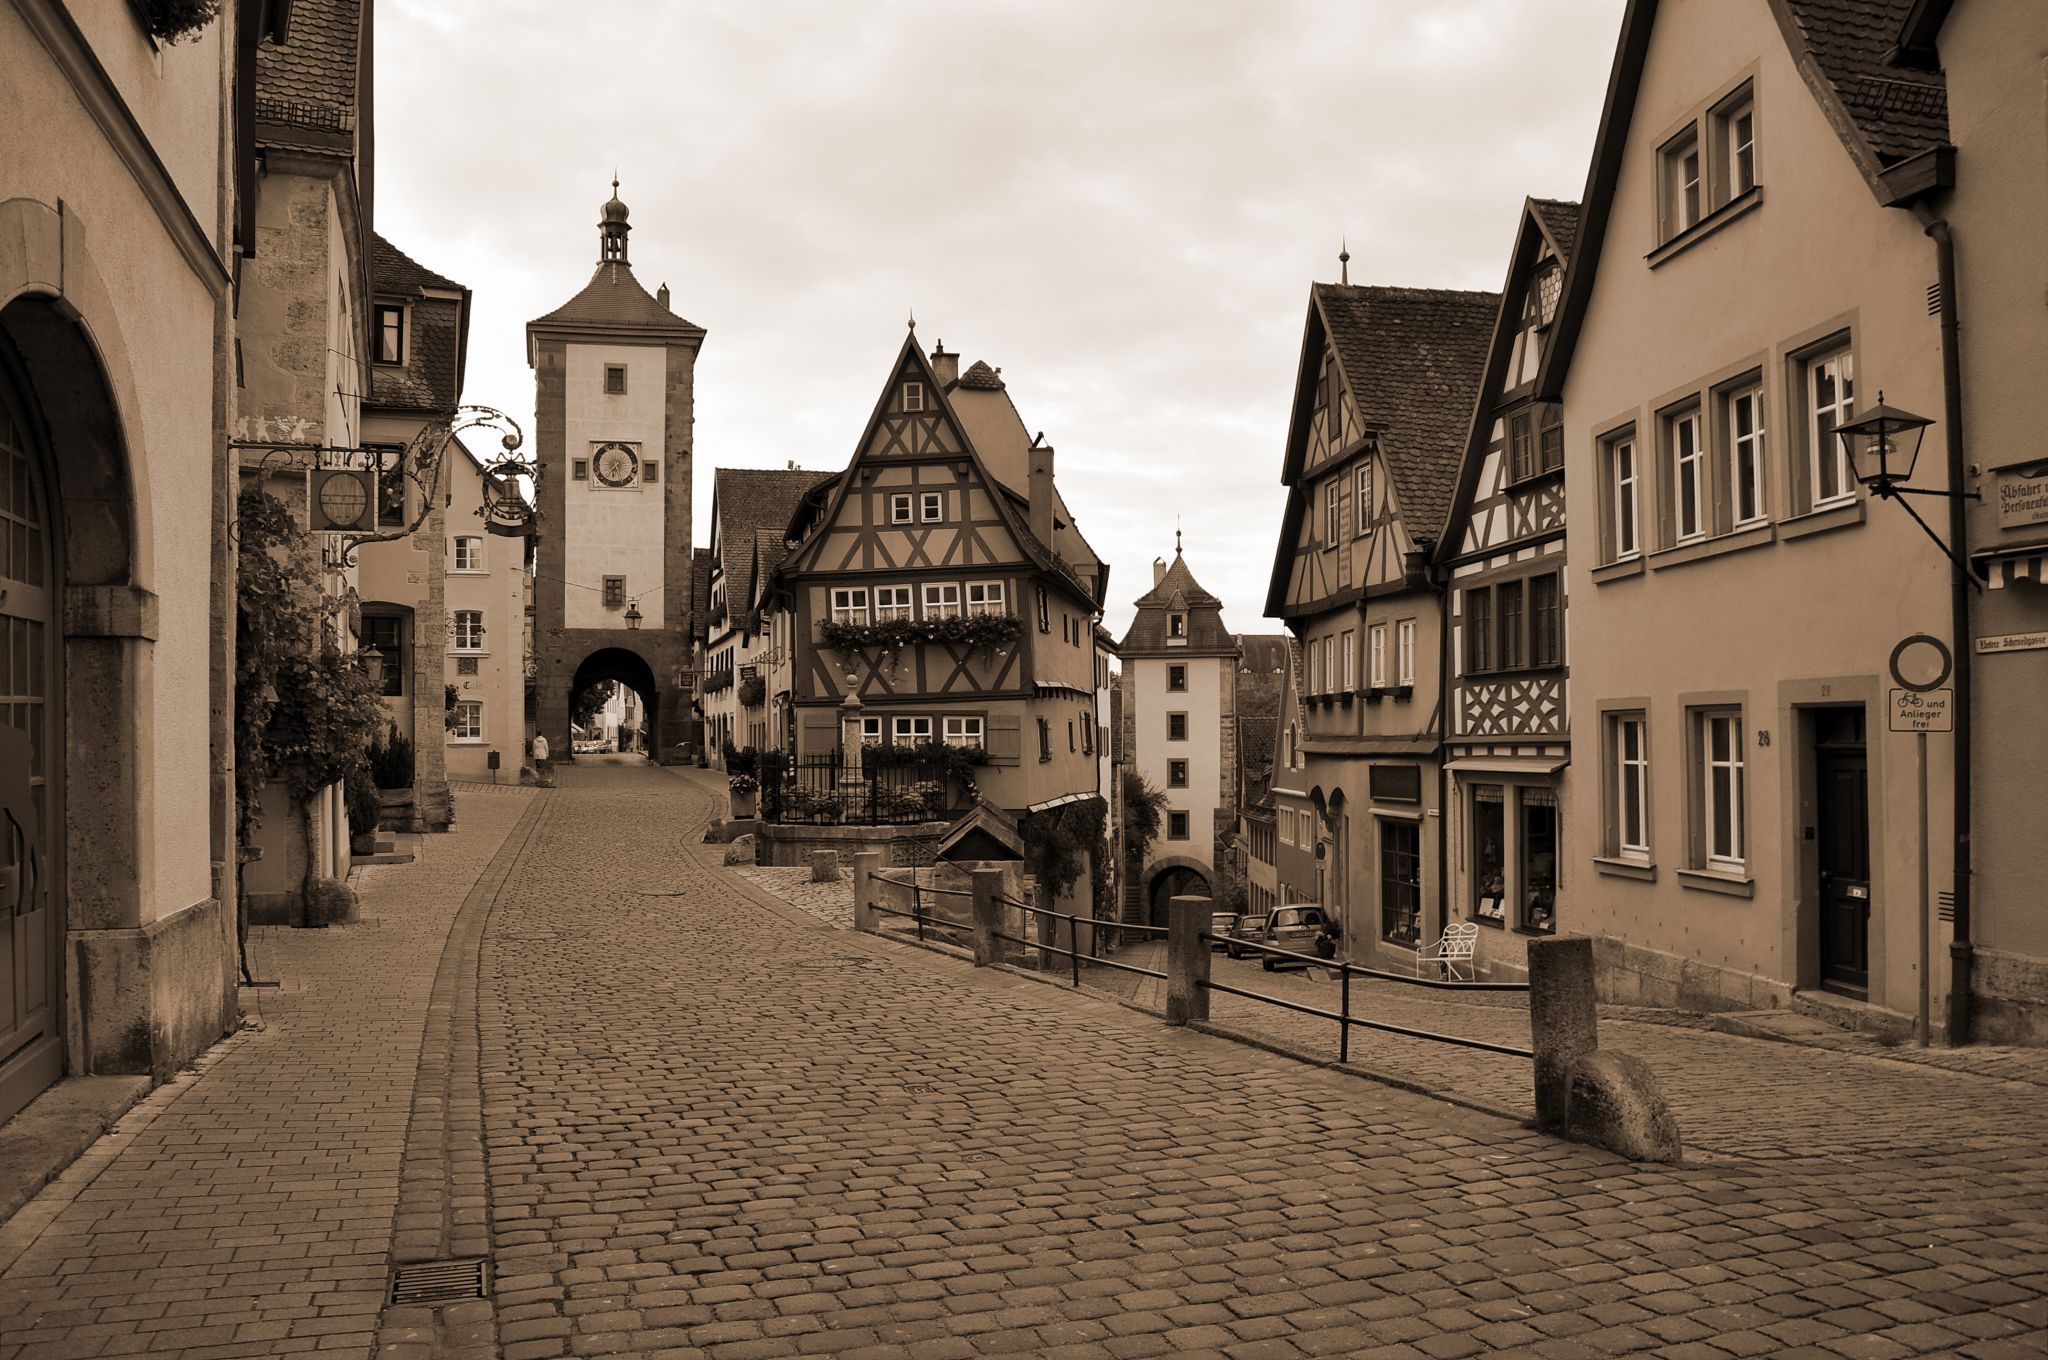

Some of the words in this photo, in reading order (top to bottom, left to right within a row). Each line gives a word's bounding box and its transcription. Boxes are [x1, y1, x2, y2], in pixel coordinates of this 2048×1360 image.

[2001, 484, 2041, 501] Abfahrt
[1926, 700, 1945, 708] und
[1900, 710, 1942, 720] Anlieger
[1912, 720, 1929, 728] frei
